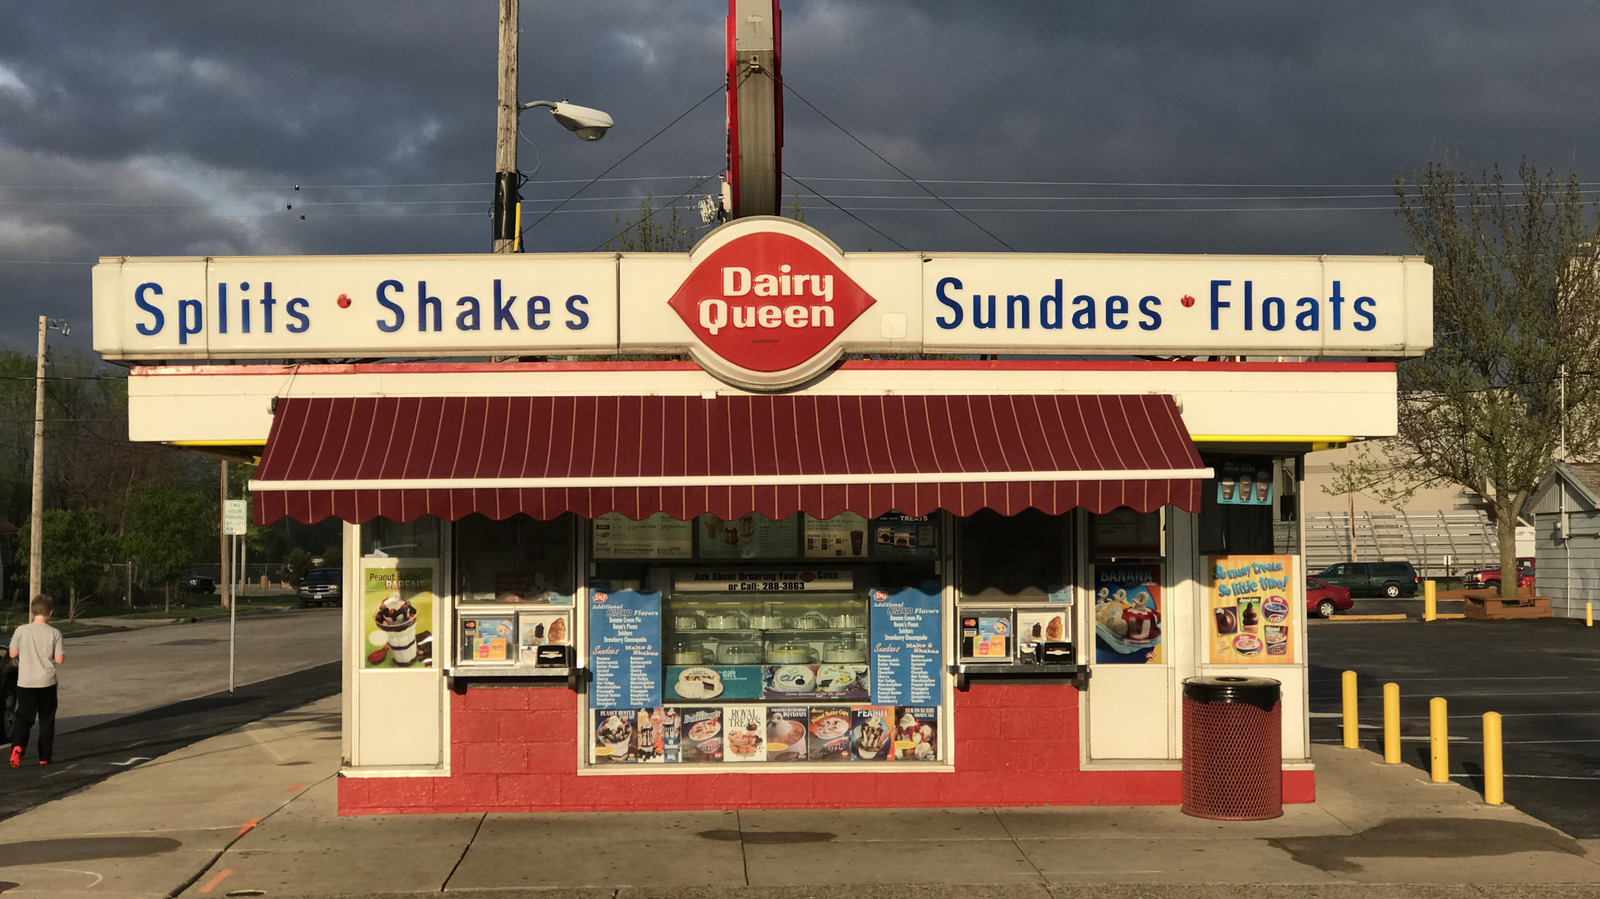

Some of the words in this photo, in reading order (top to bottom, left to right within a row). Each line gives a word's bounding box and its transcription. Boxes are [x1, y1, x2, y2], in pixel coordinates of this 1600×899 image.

[722, 264, 834, 302] Dairy
[935, 277, 1162, 331] Sundaes
[1210, 280, 1378, 332] Floats
[134, 282, 310, 345] Splits
[376, 279, 589, 333] Shakes
[698, 299, 835, 335] Queen
[369, 572, 395, 581] Peanut
[397, 572, 421, 581] Buster
[694, 572, 709, 581] Ask
[713, 572, 736, 581] About
[738, 571, 776, 582] Ordering
[778, 571, 798, 581] Your
[817, 571, 838, 580] Cake
[1100, 569, 1153, 582] BANANA
[1213, 564, 1227, 580] So
[1227, 564, 1251, 580] many
[385, 579, 425, 590] PARFAIT
[728, 583, 738, 591] or
[741, 582, 760, 591] Call:
[762, 582, 805, 591] 288-3863
[1218, 584, 1232, 598] So
[1232, 579, 1258, 595] little
[1259, 575, 1289, 592] time!
[593, 645, 619, 655] Sundaes
[874, 643, 900, 653] Sundaes
[722, 670, 737, 678] Gift
[731, 709, 759, 719] ROYAL
[857, 709, 888, 718] PEANUT
[728, 718, 761, 728] TREATS
